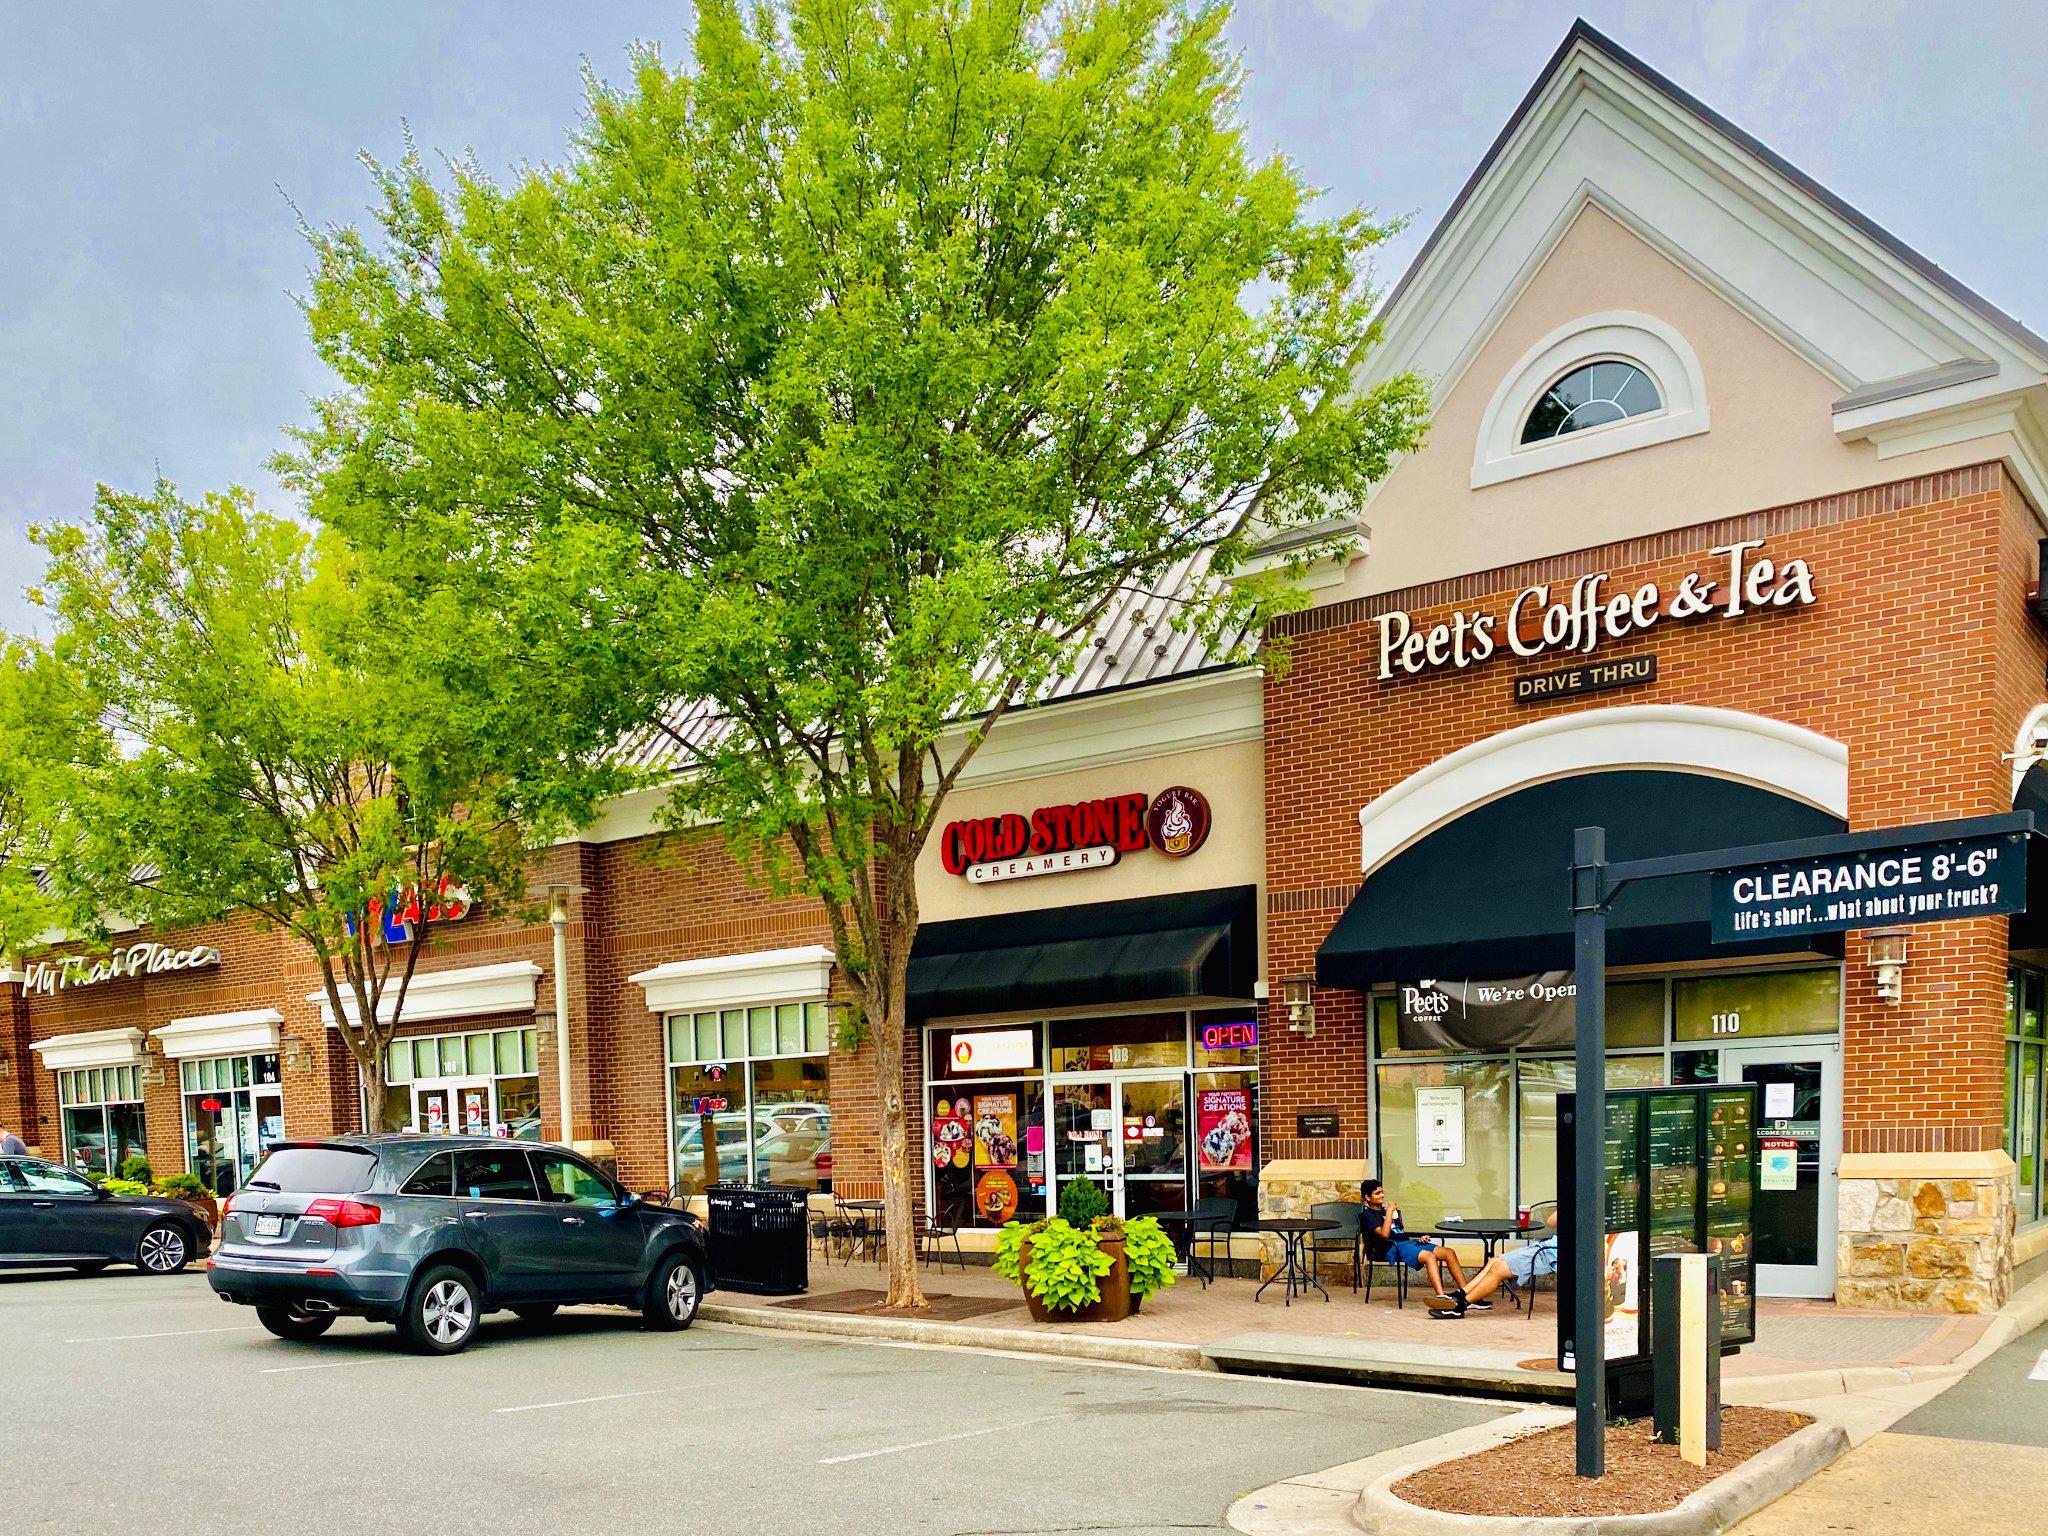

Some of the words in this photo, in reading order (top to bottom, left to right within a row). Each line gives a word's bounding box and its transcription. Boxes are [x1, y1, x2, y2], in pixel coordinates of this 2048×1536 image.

[1373, 611, 1495, 680] Peet's
[1507, 573, 1658, 656] Coffee
[1669, 572, 1717, 618] &
[1709, 539, 1817, 618] Tea
[1518, 671, 1582, 697] DRIVE
[1589, 660, 1651, 684] THRU
[1153, 789, 1182, 811] YOGURT
[1184, 791, 1198, 805] BAR
[941, 813, 1030, 875] COLD
[1030, 793, 1148, 854] STONE
[975, 850, 1107, 879] CREAMERY
[1733, 856, 1922, 904] CLEARANCE
[1931, 848, 1998, 882] 8'-6"
[1734, 909, 1771, 931] Life's
[1865, 894, 1905, 918] about
[1908, 891, 1943, 916] your
[1947, 883, 1999, 908] truck?
[22, 961, 56, 998] My
[126, 943, 214, 977] Place
[1402, 987, 1449, 1015] Peet's
[1477, 986, 1525, 1002] We're
[1529, 983, 1577, 1002] Open
[1711, 1012, 1740, 1034] 110
[1205, 1024, 1254, 1048] OPEN
[1107, 1047, 1129, 1063] 108
[263, 1071, 276, 1083] 104
[709, 1097, 727, 1111] ABC
[977, 1100, 1012, 1108] SIGNATURE
[977, 1106, 1013, 1115] CREATIONS
[1203, 1096, 1246, 1104] SIGNATURE
[1203, 1103, 1246, 1111] CREATIONS
